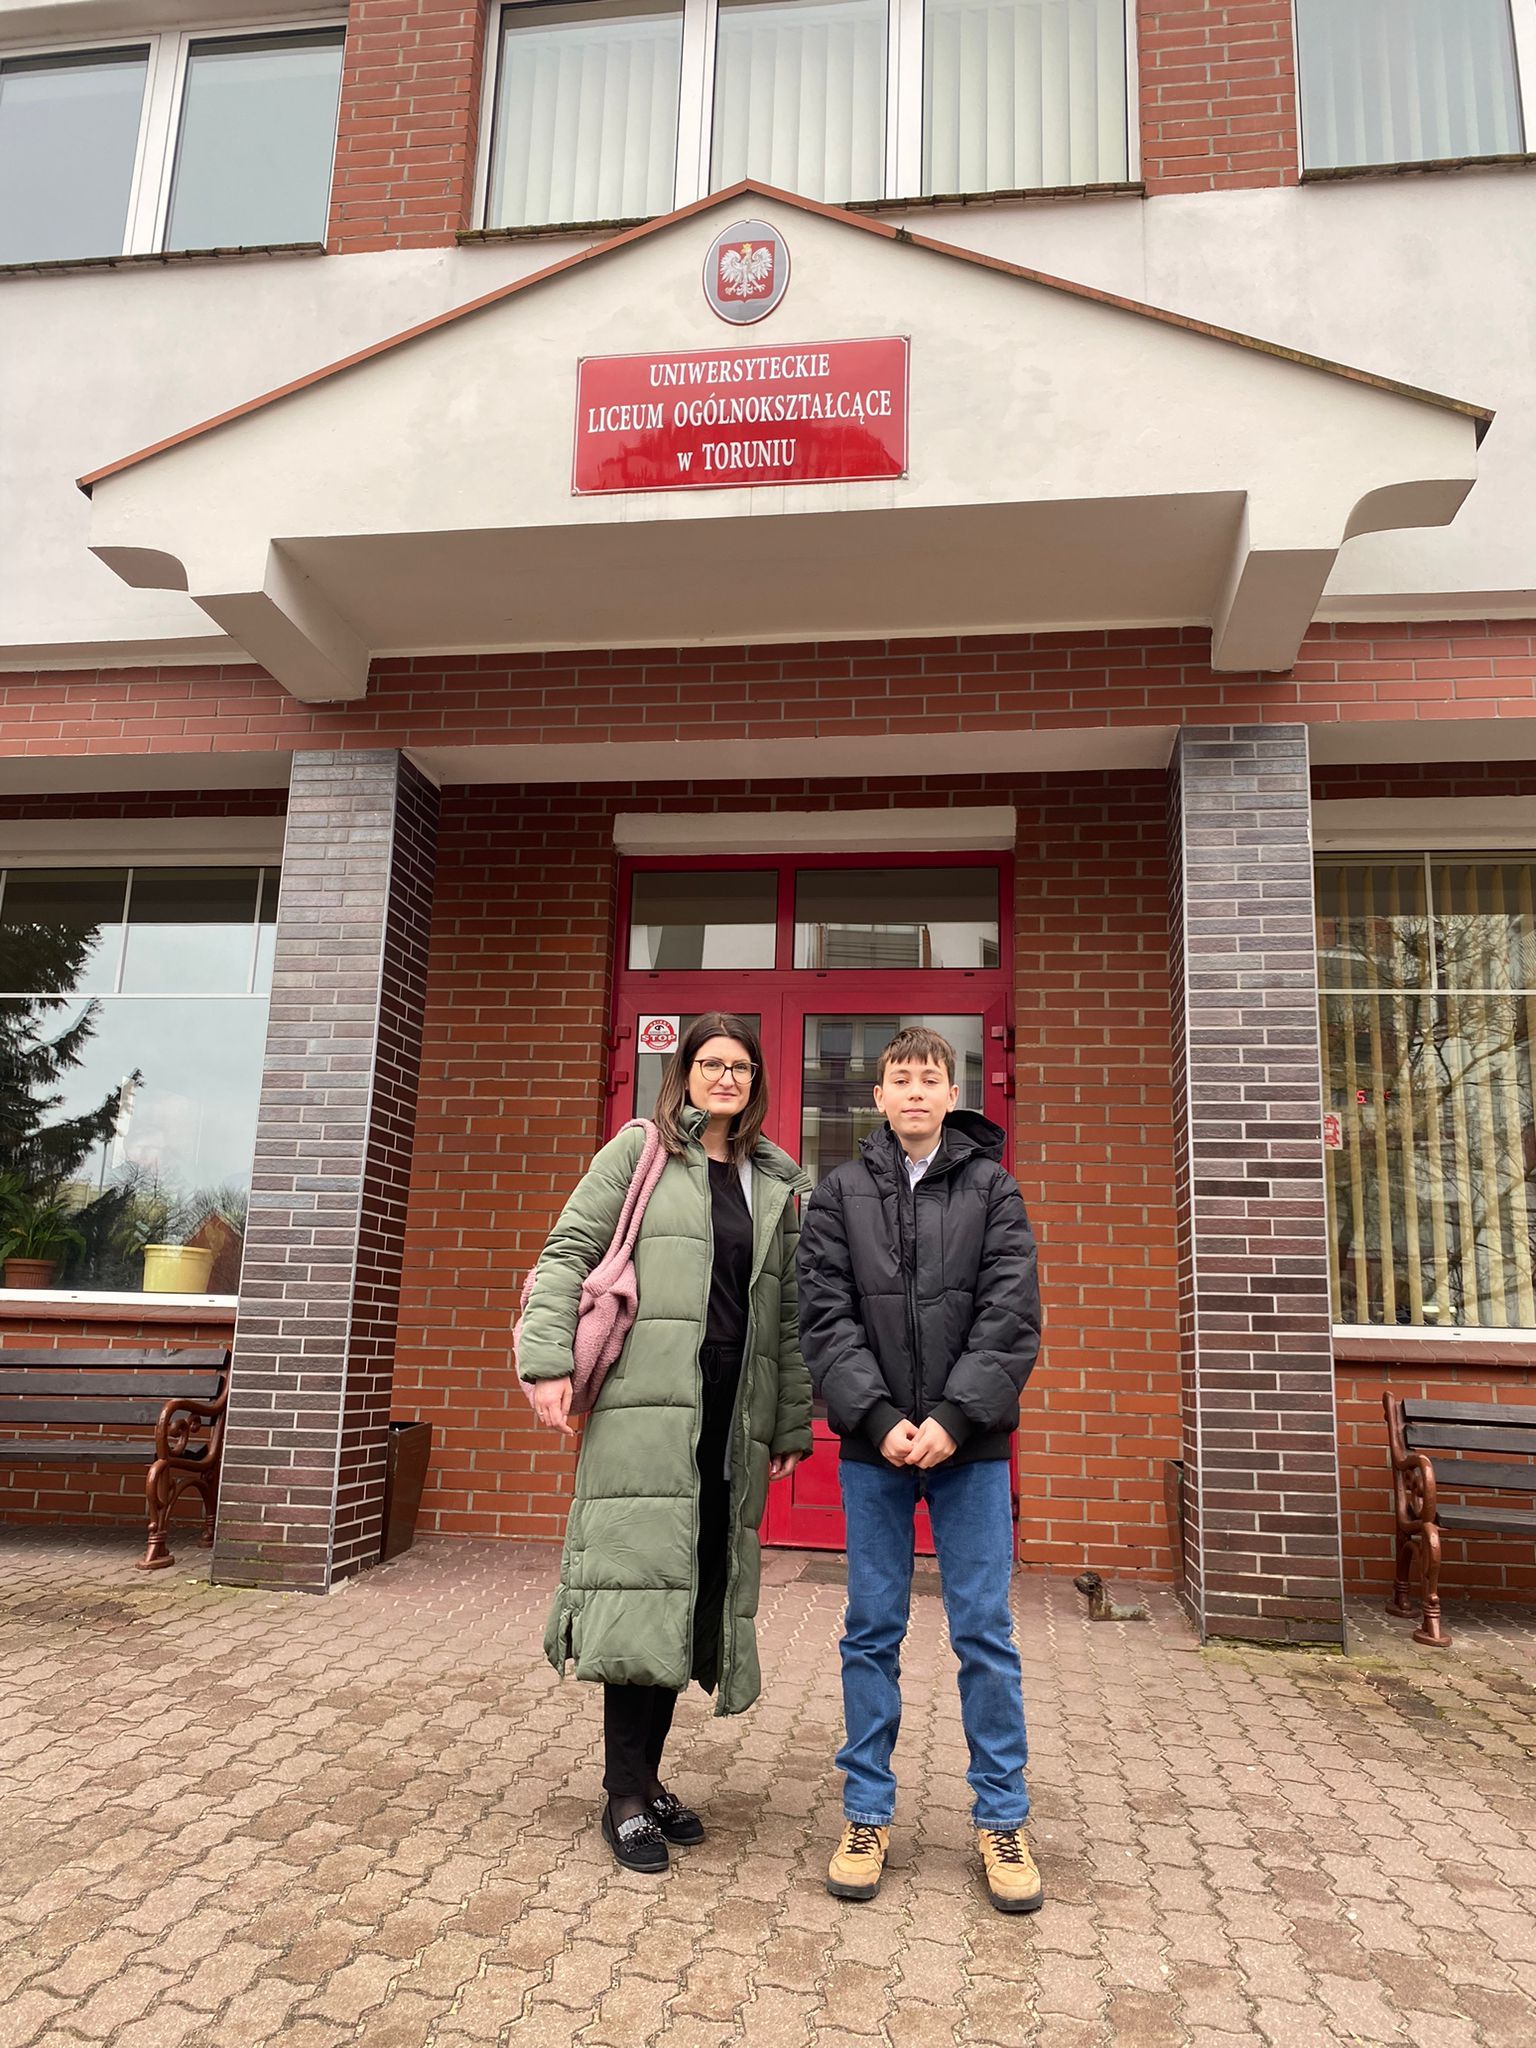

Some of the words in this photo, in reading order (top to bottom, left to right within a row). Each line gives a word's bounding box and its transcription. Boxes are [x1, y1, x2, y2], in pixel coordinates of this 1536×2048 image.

[650, 354, 829, 386] UNIWERSYTECKIE
[587, 403, 664, 434] LICEUM
[674, 389, 892, 425] OGÓLNOKSZTAŁCĄCE
[677, 452, 693, 472] w
[703, 439, 795, 469] TORUNIU
[641, 1034, 677, 1042] STOP
